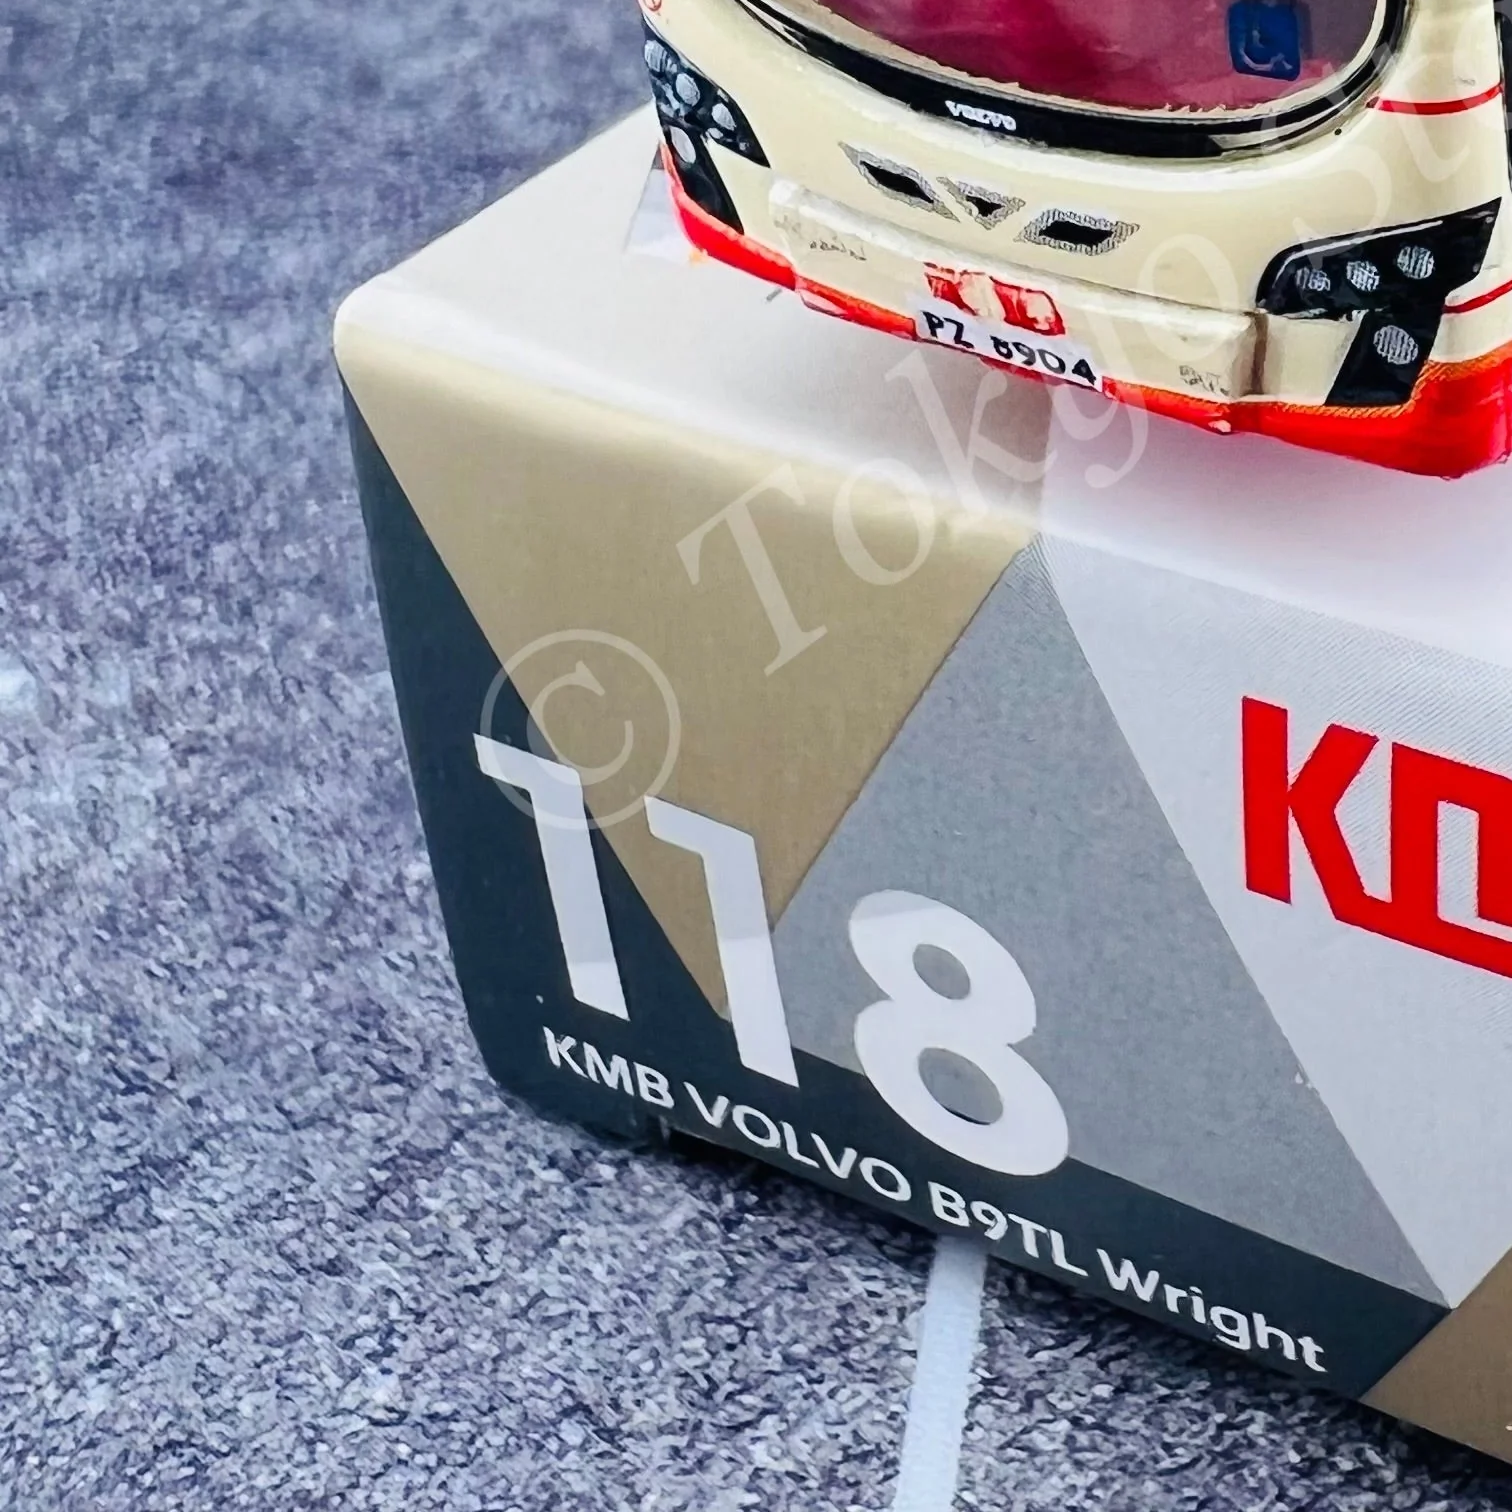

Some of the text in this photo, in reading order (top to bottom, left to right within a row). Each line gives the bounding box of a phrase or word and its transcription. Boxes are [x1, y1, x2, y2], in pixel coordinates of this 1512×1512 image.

[920, 309, 975, 350] PZ
[473, 732, 1071, 1177] 118
[542, 1025, 1329, 1373] KMB VOLVO B9TL Wright
